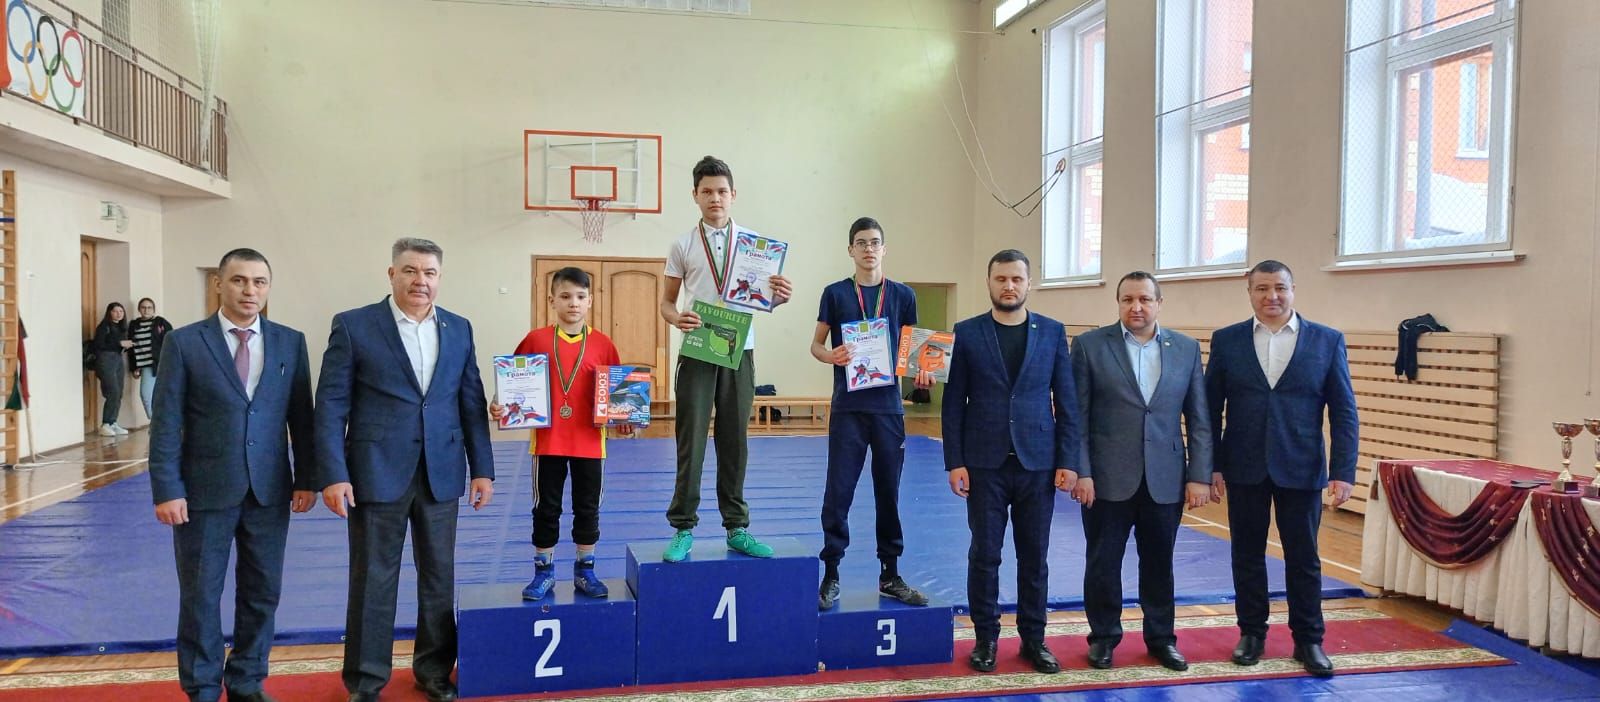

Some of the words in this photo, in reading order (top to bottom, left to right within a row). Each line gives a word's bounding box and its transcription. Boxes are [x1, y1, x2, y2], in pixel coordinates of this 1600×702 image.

[746, 249, 772, 260] Грамота
[695, 303, 748, 324] FAVOURITE
[853, 335, 878, 343] Грамота
[598, 372, 607, 403] СОЮЗ
[713, 587, 737, 642] 1
[534, 619, 563, 678] 2
[877, 619, 897, 656] 3
